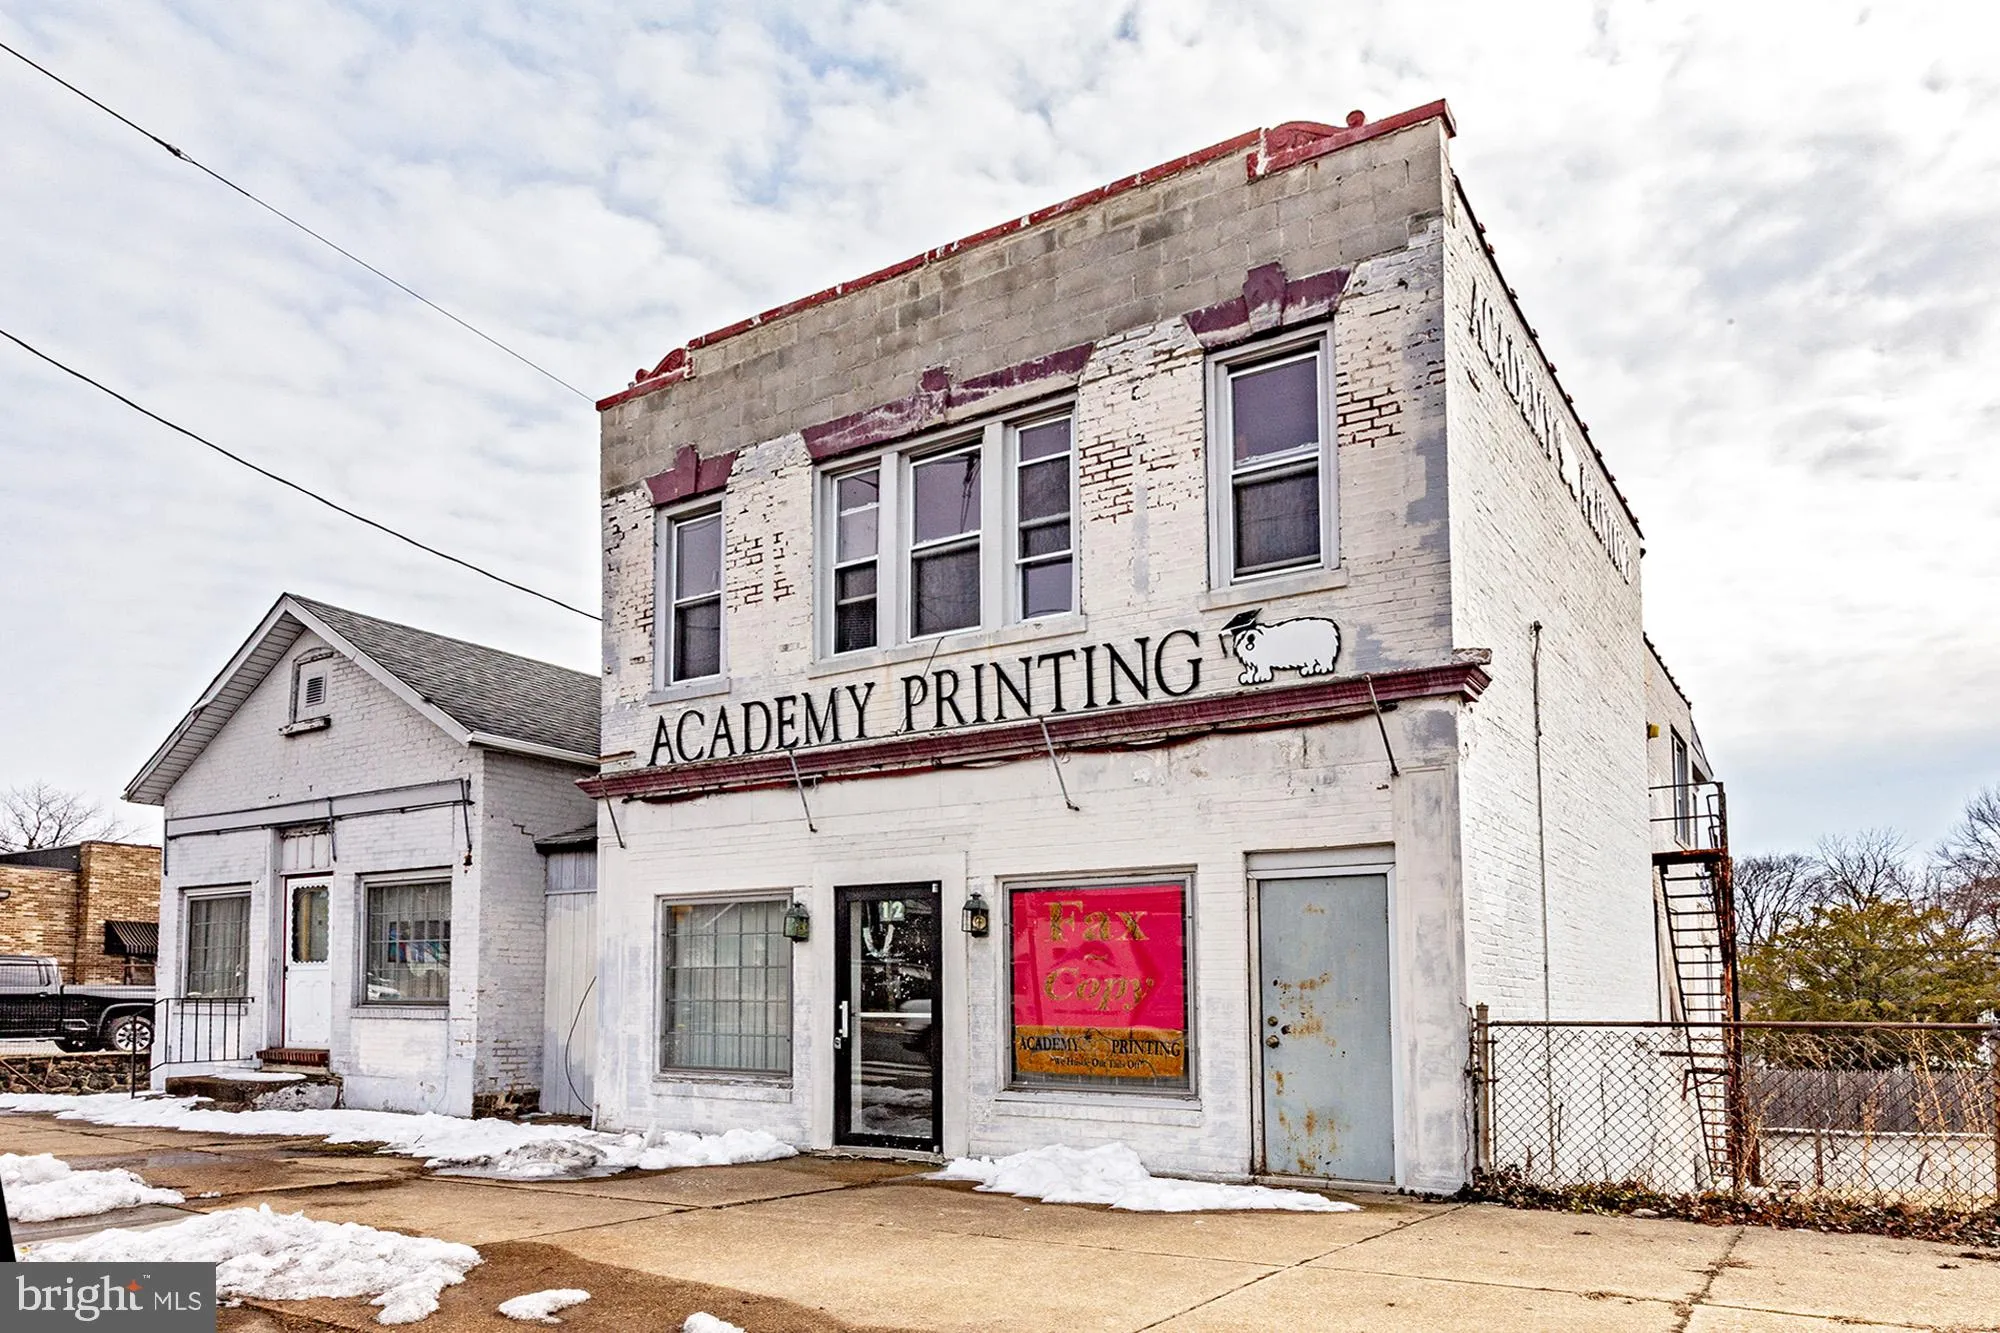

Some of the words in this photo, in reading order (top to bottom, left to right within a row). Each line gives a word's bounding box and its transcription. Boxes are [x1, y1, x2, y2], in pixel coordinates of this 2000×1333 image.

[647, 681, 876, 767] ACADEMY
[901, 629, 1204, 730] PRINTING
[1044, 899, 1150, 943] Fax
[1044, 966, 1155, 1012] Copy
[1019, 1035, 1079, 1052] ACADEMY
[1112, 1038, 1182, 1058] PRINTING
